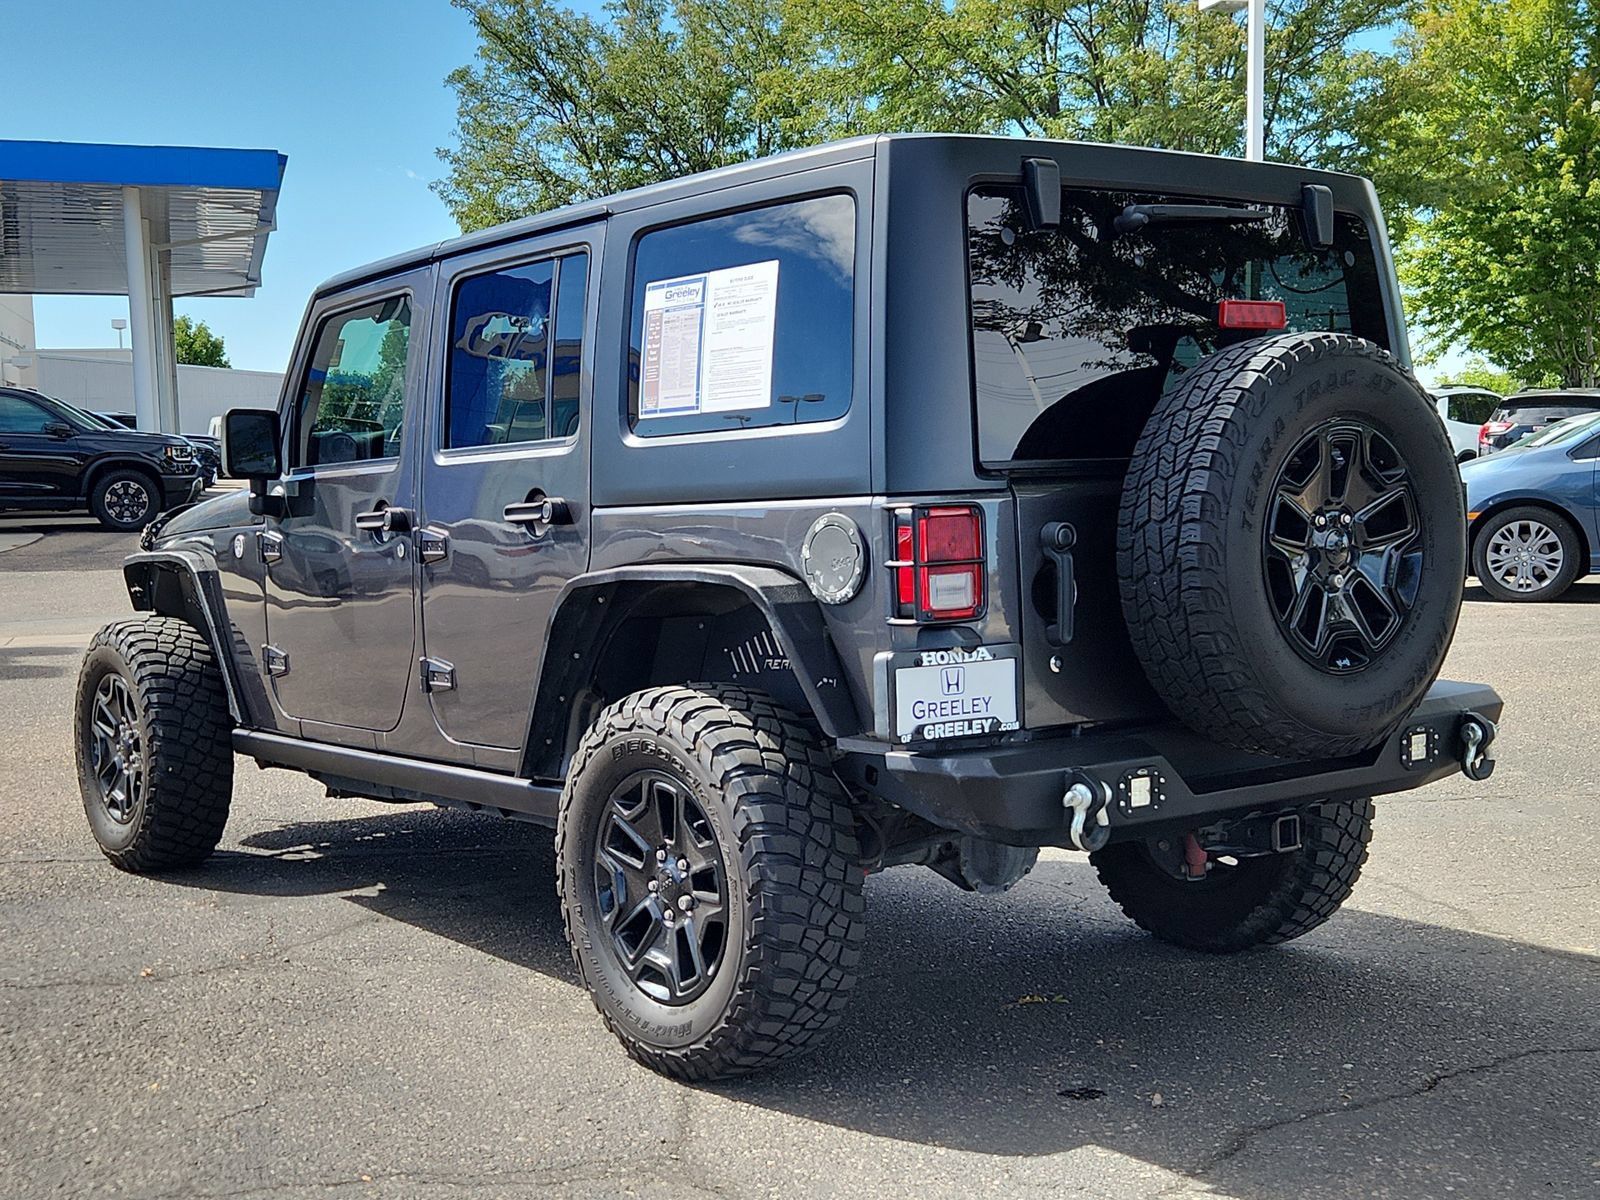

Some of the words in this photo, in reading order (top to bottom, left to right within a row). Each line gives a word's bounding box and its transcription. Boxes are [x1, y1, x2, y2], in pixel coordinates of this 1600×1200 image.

[665, 287, 700, 299] Greeley
[764, 659, 793, 670] REA
[921, 647, 993, 666] HONDA
[912, 696, 992, 719] GREELEY
[901, 734, 912, 744] OF
[923, 718, 993, 740] GREELEY
